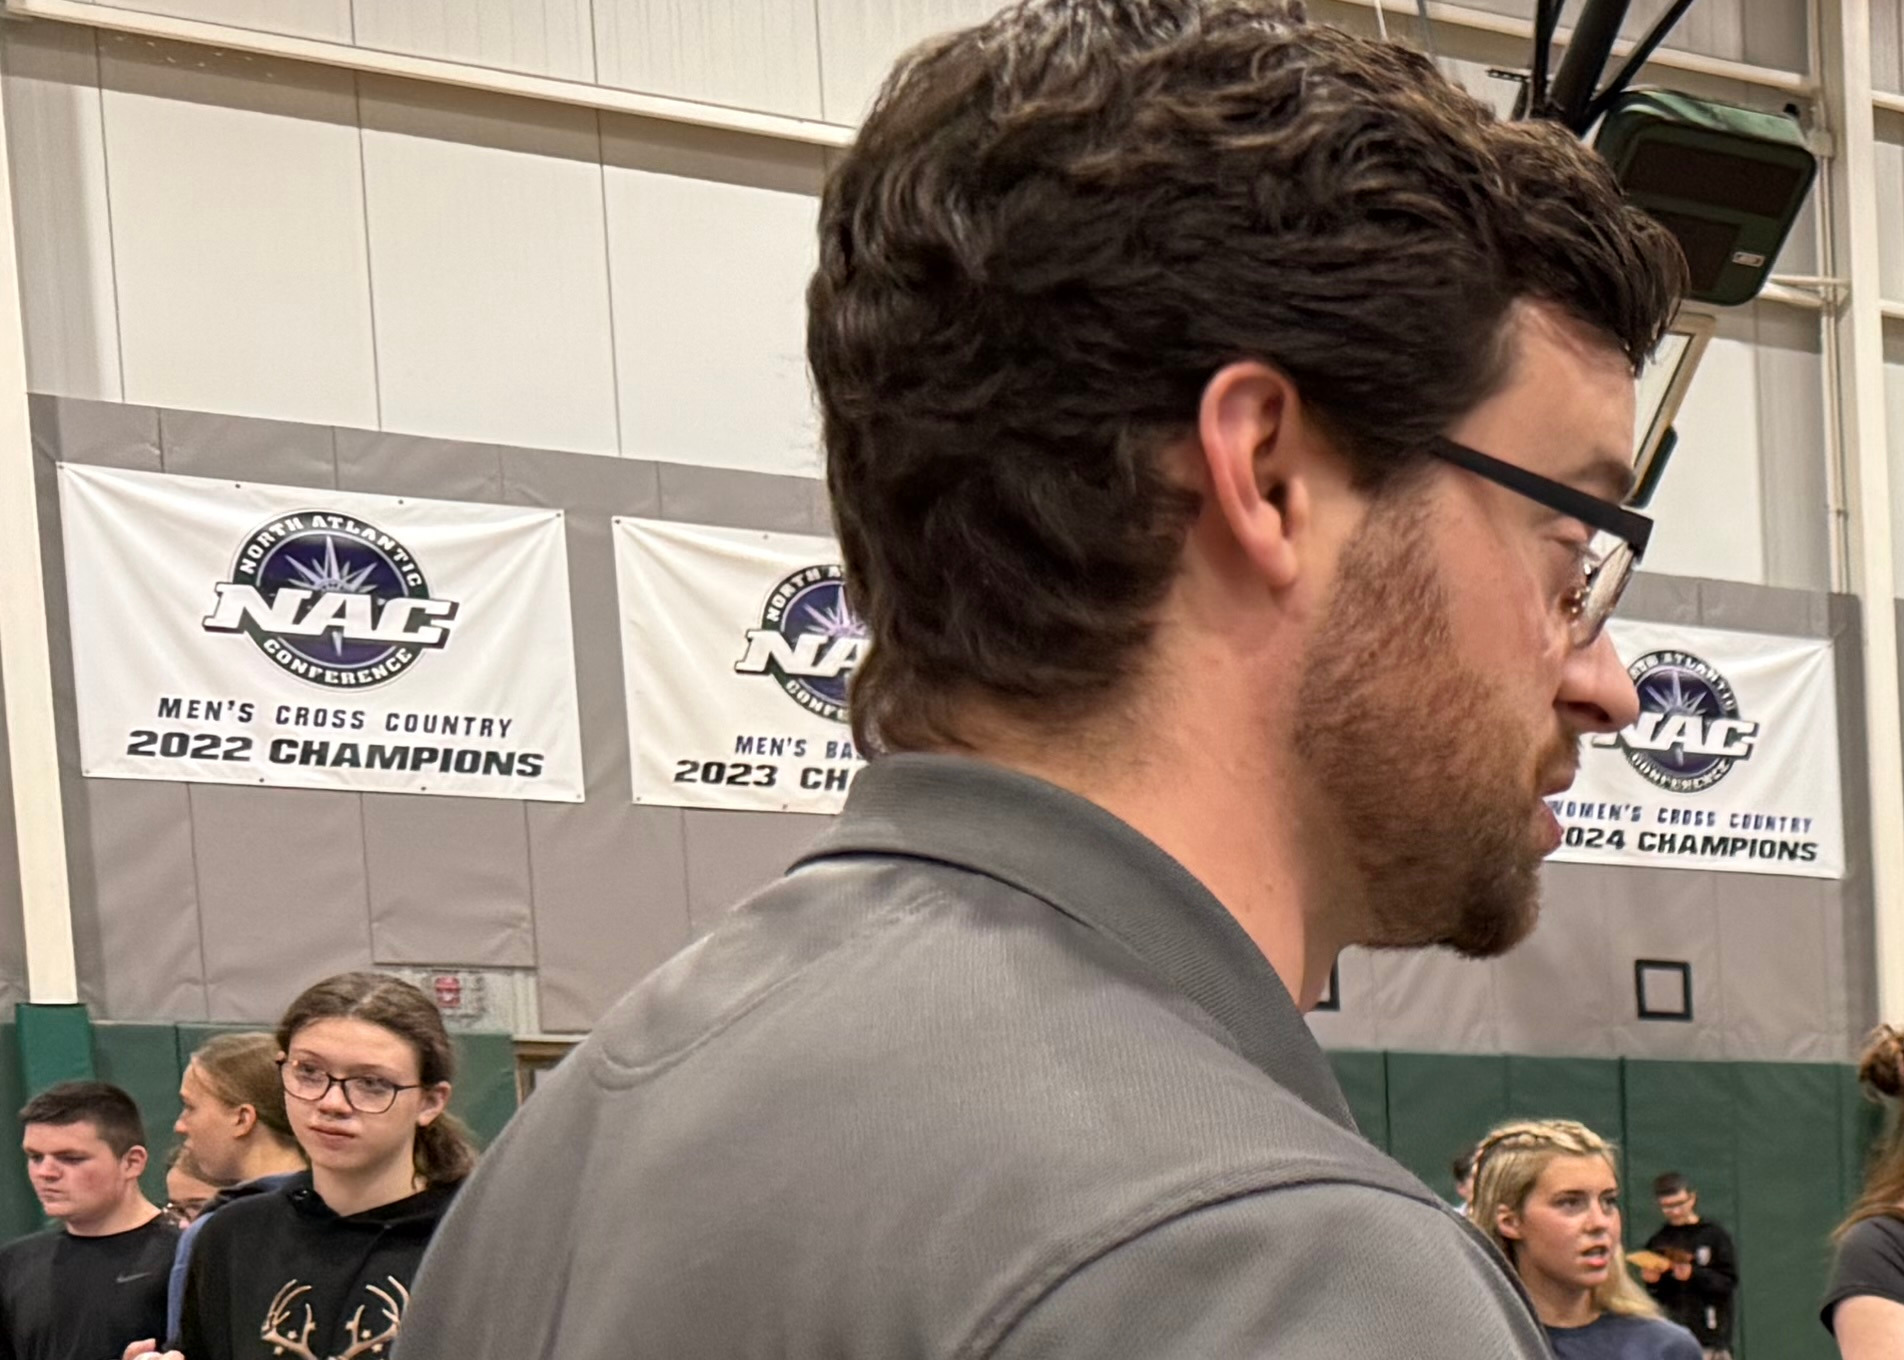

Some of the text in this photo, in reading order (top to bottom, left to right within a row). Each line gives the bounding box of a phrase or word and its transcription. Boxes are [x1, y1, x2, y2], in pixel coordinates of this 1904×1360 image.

[240, 515, 422, 587] NORTH ATLANTIC
[202, 582, 460, 648] NAC
[766, 567, 821, 622] NORTH
[263, 638, 413, 685] CONFERENCE
[734, 628, 871, 677] NA
[157, 697, 512, 738] MEN'S CROSS COUNTRY
[127, 730, 545, 777] 2022 CHAMPIONS
[735, 735, 807, 757] MEN'S
[674, 760, 849, 791] 2023 CH
[1565, 826, 1819, 862] 024 CHAMPIONS
[1657, 807, 1716, 827] CROSS
[1729, 812, 1814, 834] COUNTRY
